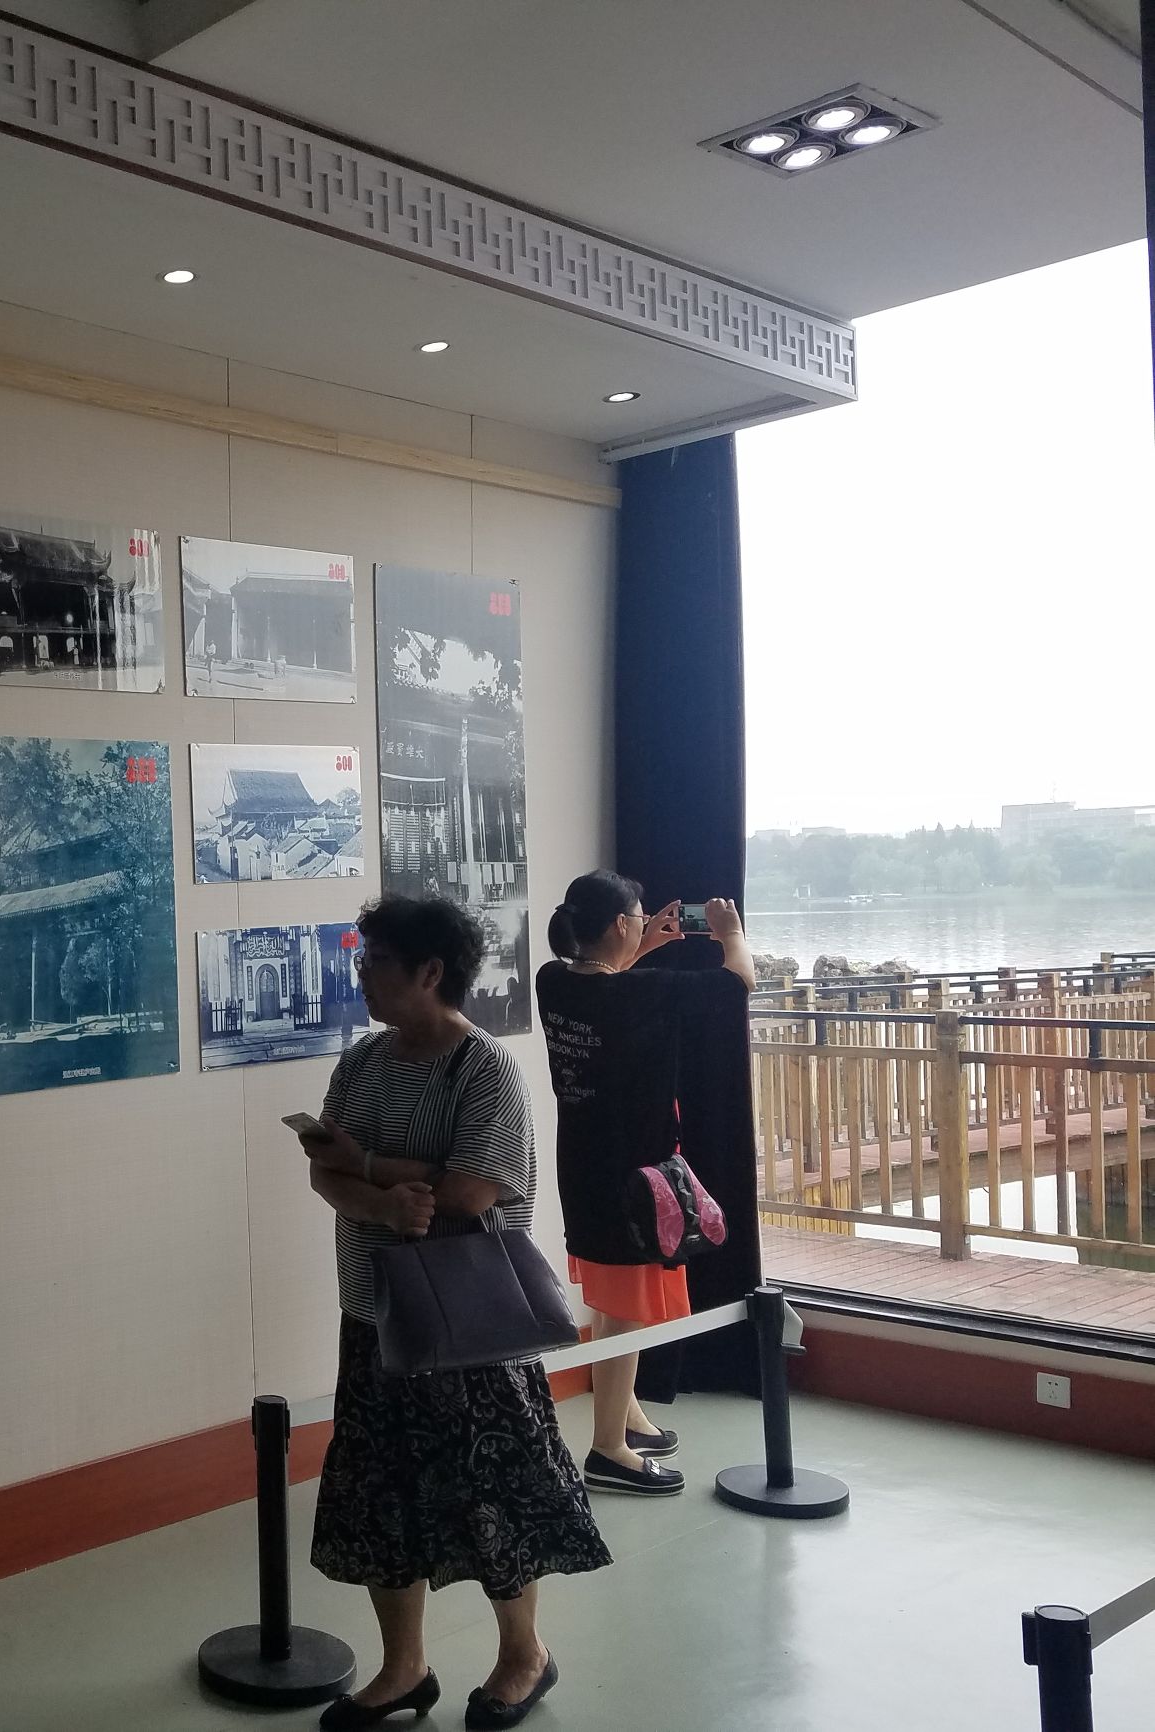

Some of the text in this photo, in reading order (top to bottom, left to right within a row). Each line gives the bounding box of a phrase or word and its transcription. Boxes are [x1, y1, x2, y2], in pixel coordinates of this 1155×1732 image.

[547, 1011, 593, 1035] NEW YORK
[558, 1031, 603, 1047] ANGELES
